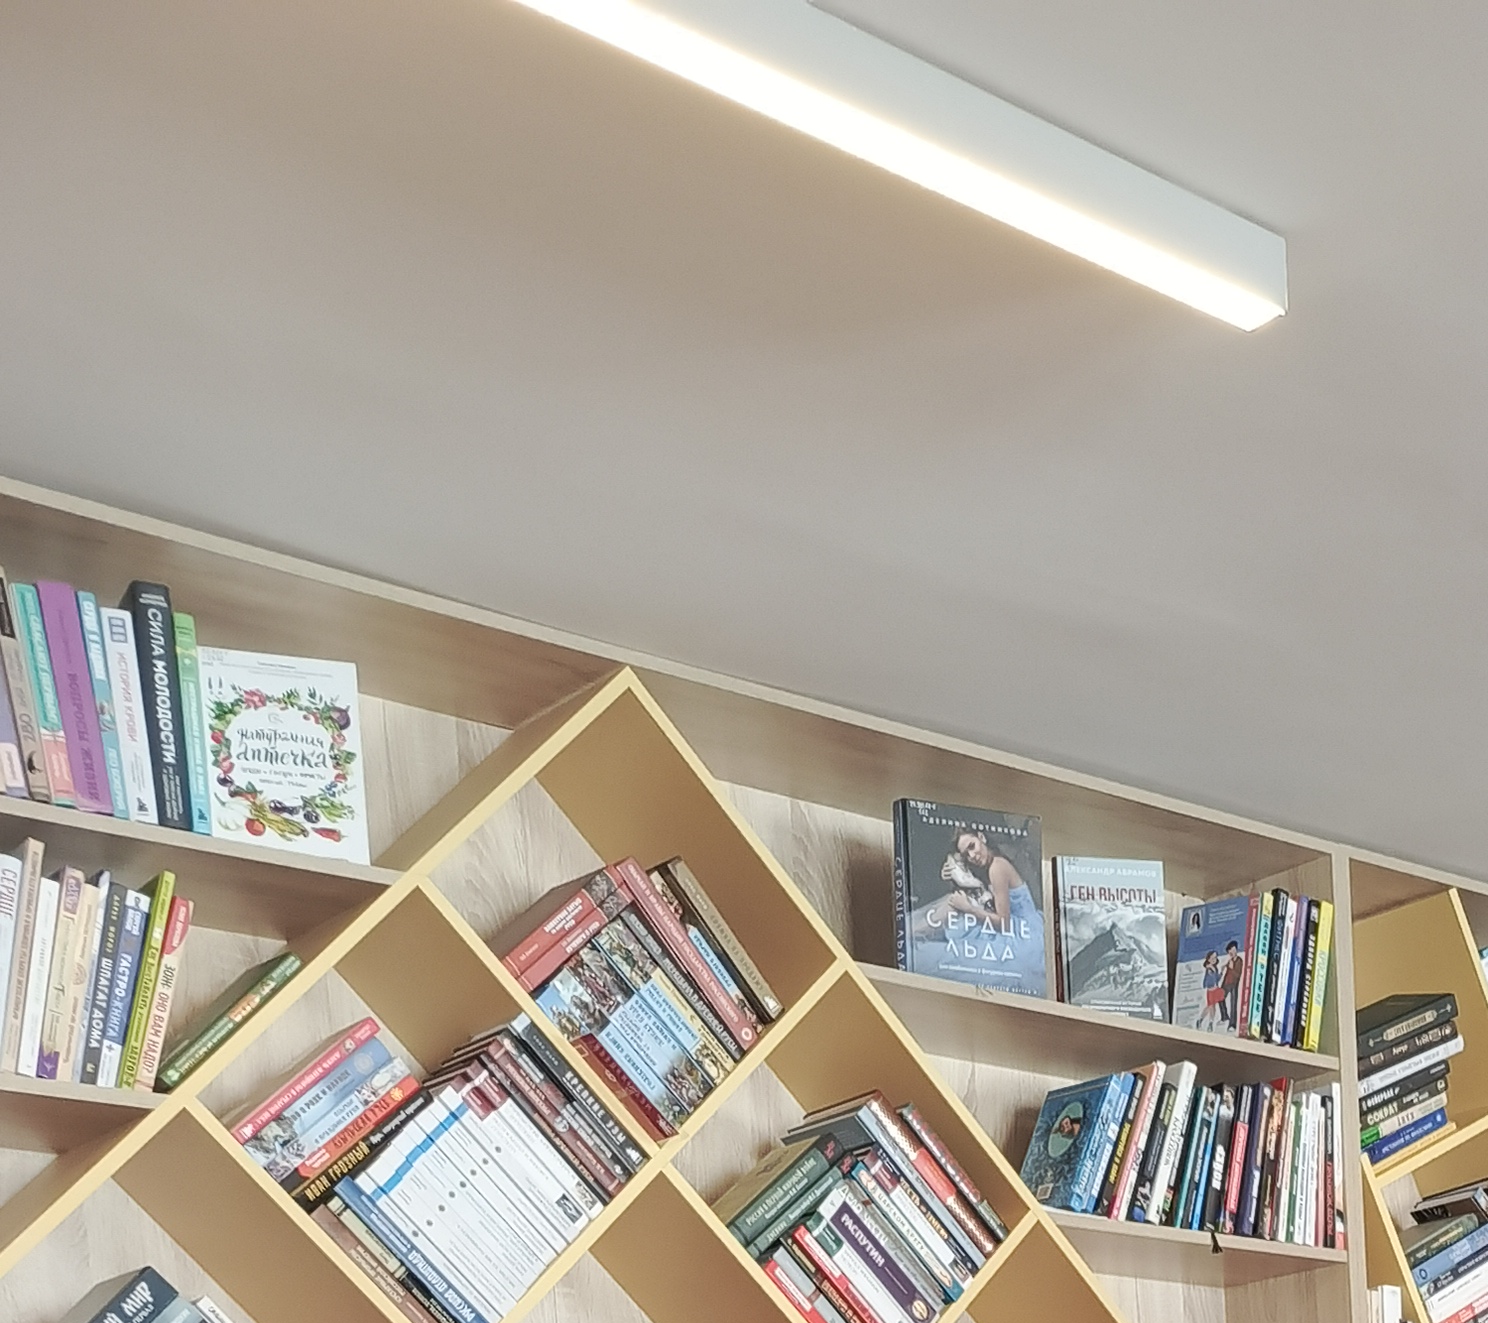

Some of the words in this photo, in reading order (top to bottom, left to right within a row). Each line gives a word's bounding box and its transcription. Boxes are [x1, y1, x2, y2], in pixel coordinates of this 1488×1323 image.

[146, 606, 168, 656] СИЛА
[115, 650, 133, 705] ИСТОРИЯ
[148, 658, 180, 764] МОЛОДОСТИ
[1070, 885, 1095, 901] ГЕН
[1098, 886, 1157, 904] ВЫСОТЫ
[926, 909, 1031, 940] СЕРДЦЕ
[946, 939, 1017, 962] ЛЬДА
[303, 1174, 331, 1202] ИВАН
[324, 1138, 371, 1181] ГРОЗНЫЙ
[837, 1213, 889, 1268] РАСПУТИН
[117, 1279, 160, 1321] МИР
